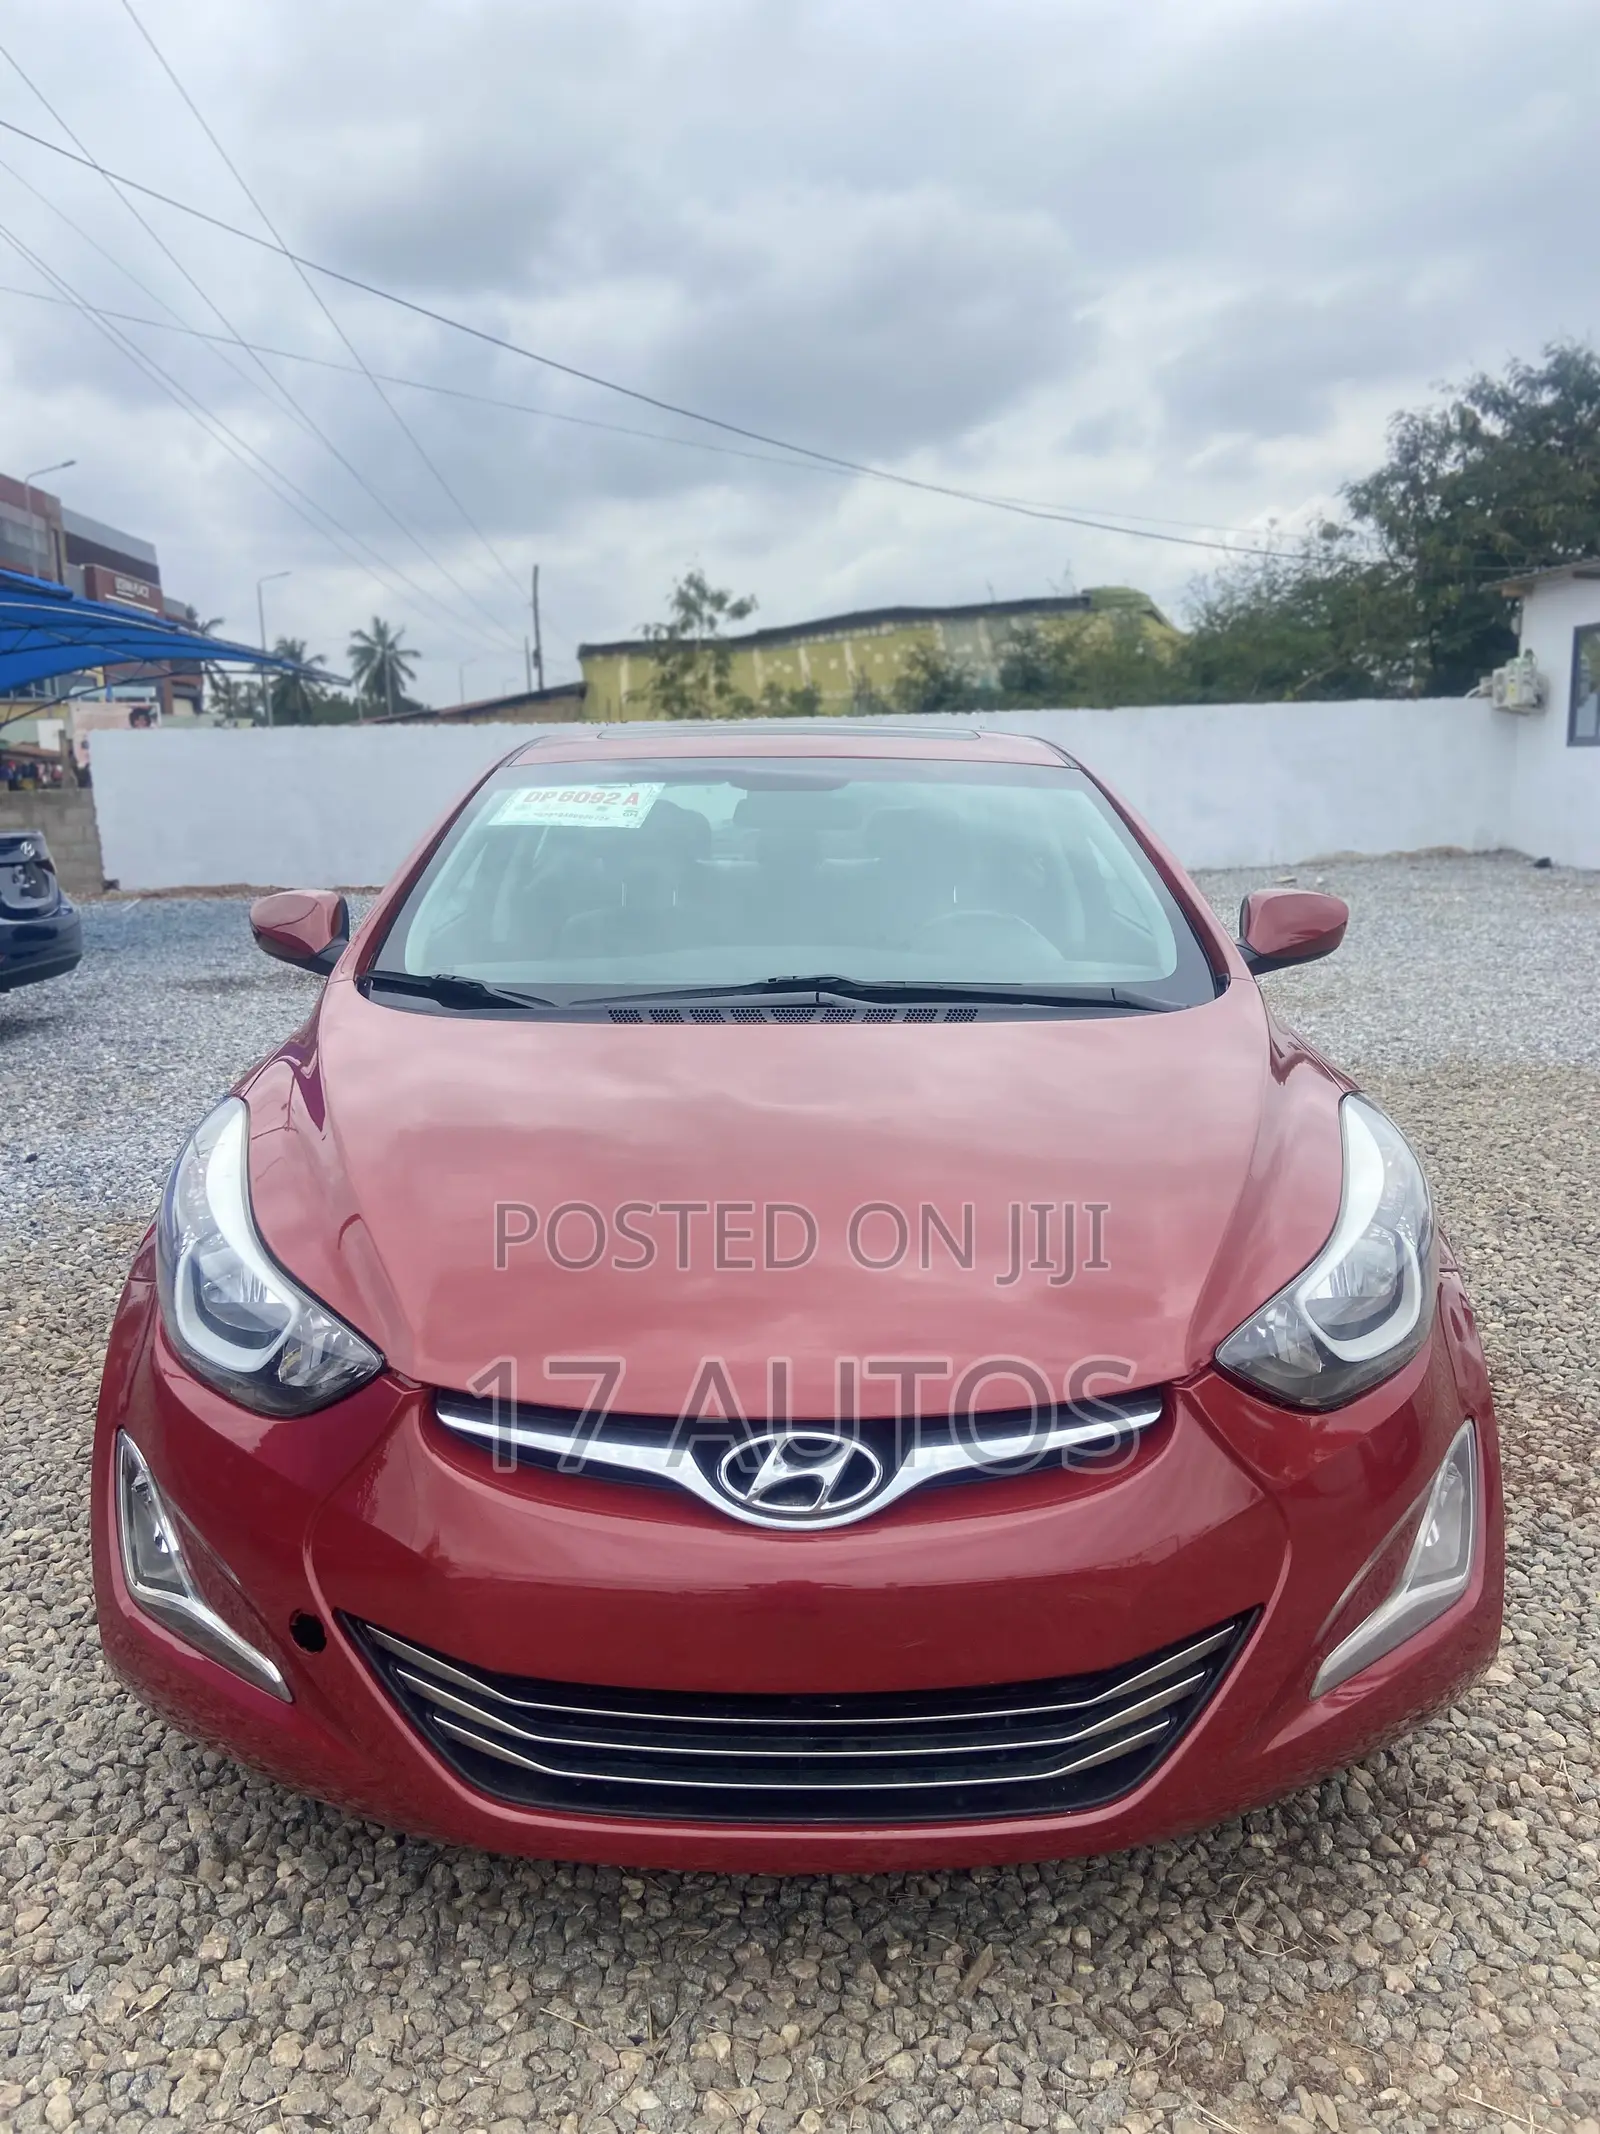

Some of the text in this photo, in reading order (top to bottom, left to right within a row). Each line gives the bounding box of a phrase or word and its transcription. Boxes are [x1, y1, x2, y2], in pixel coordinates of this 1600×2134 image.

[523, 791, 640, 806] DP 6092 A
